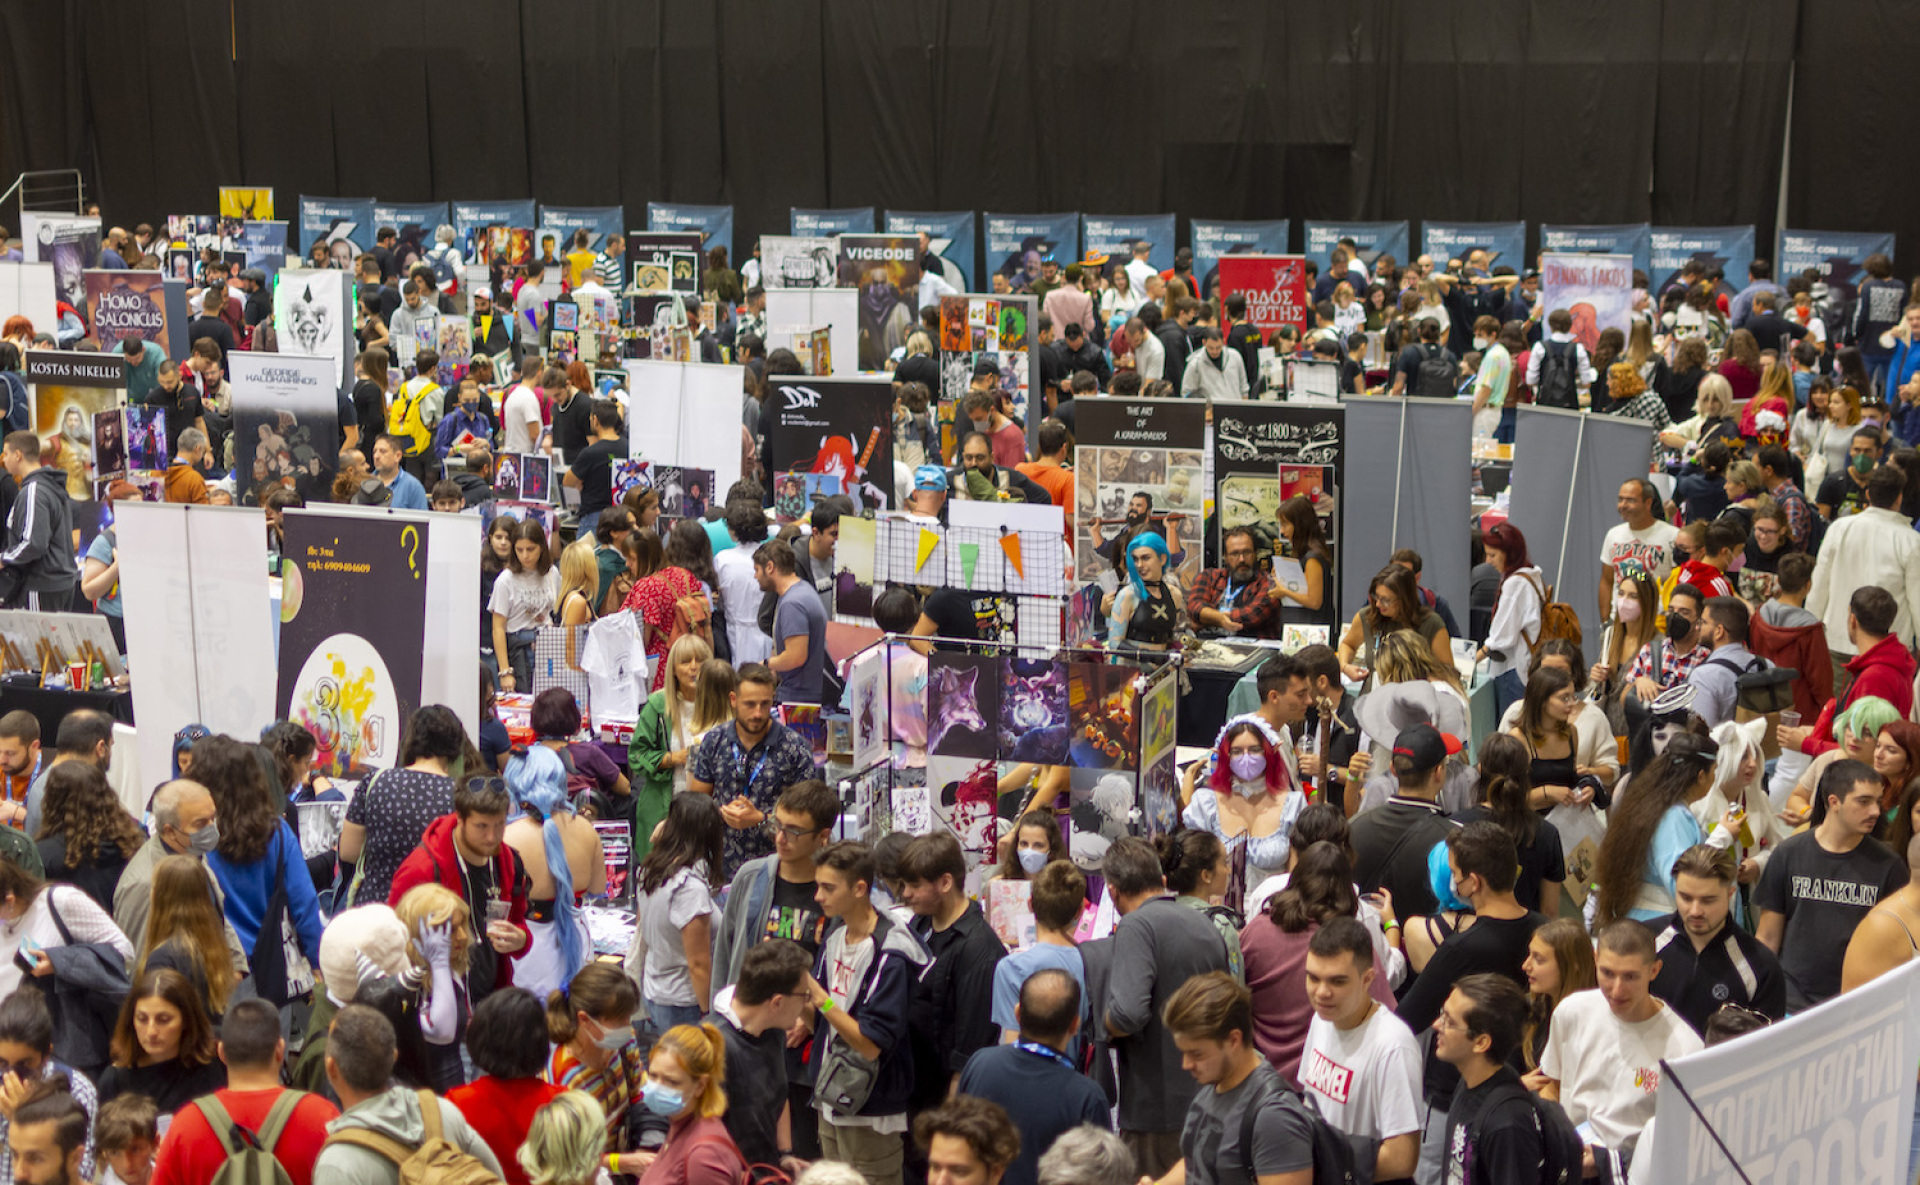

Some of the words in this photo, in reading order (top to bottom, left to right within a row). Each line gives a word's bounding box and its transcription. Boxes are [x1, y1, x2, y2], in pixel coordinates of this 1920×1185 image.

[480, 213, 495, 221] CON
[676, 216, 692, 225] CON
[567, 218, 583, 226] CON
[819, 221, 835, 229] CON
[914, 224, 931, 232] CON
[1016, 226, 1033, 235] CON
[1113, 228, 1131, 236] CON
[1224, 233, 1242, 241] CON
[1339, 234, 1358, 243] CN
[1457, 236, 1476, 244] CON
[1577, 239, 1598, 247] CON
[1682, 241, 1702, 249] CON
[846, 247, 915, 261] VICEODE
[1816, 245, 1838, 254] CON
[1546, 264, 1589, 286] DENNIS
[1591, 266, 1628, 288] FAKOS
[99, 292, 142, 310] HOMO
[1233, 289, 1294, 306] ΩΔΟΣ
[95, 309, 164, 328] SALONICUS
[30, 361, 70, 376] KOSTAS
[72, 365, 121, 379] NIKELLIS
[262, 367, 301, 376] GEORGE
[1126, 406, 1140, 416] THE
[1140, 406, 1154, 416] ART
[1136, 419, 1147, 428] OF
[1267, 423, 1290, 440] 1800
[1791, 875, 1879, 907] FRANKLIN
[1305, 1048, 1350, 1103] MARVEL
